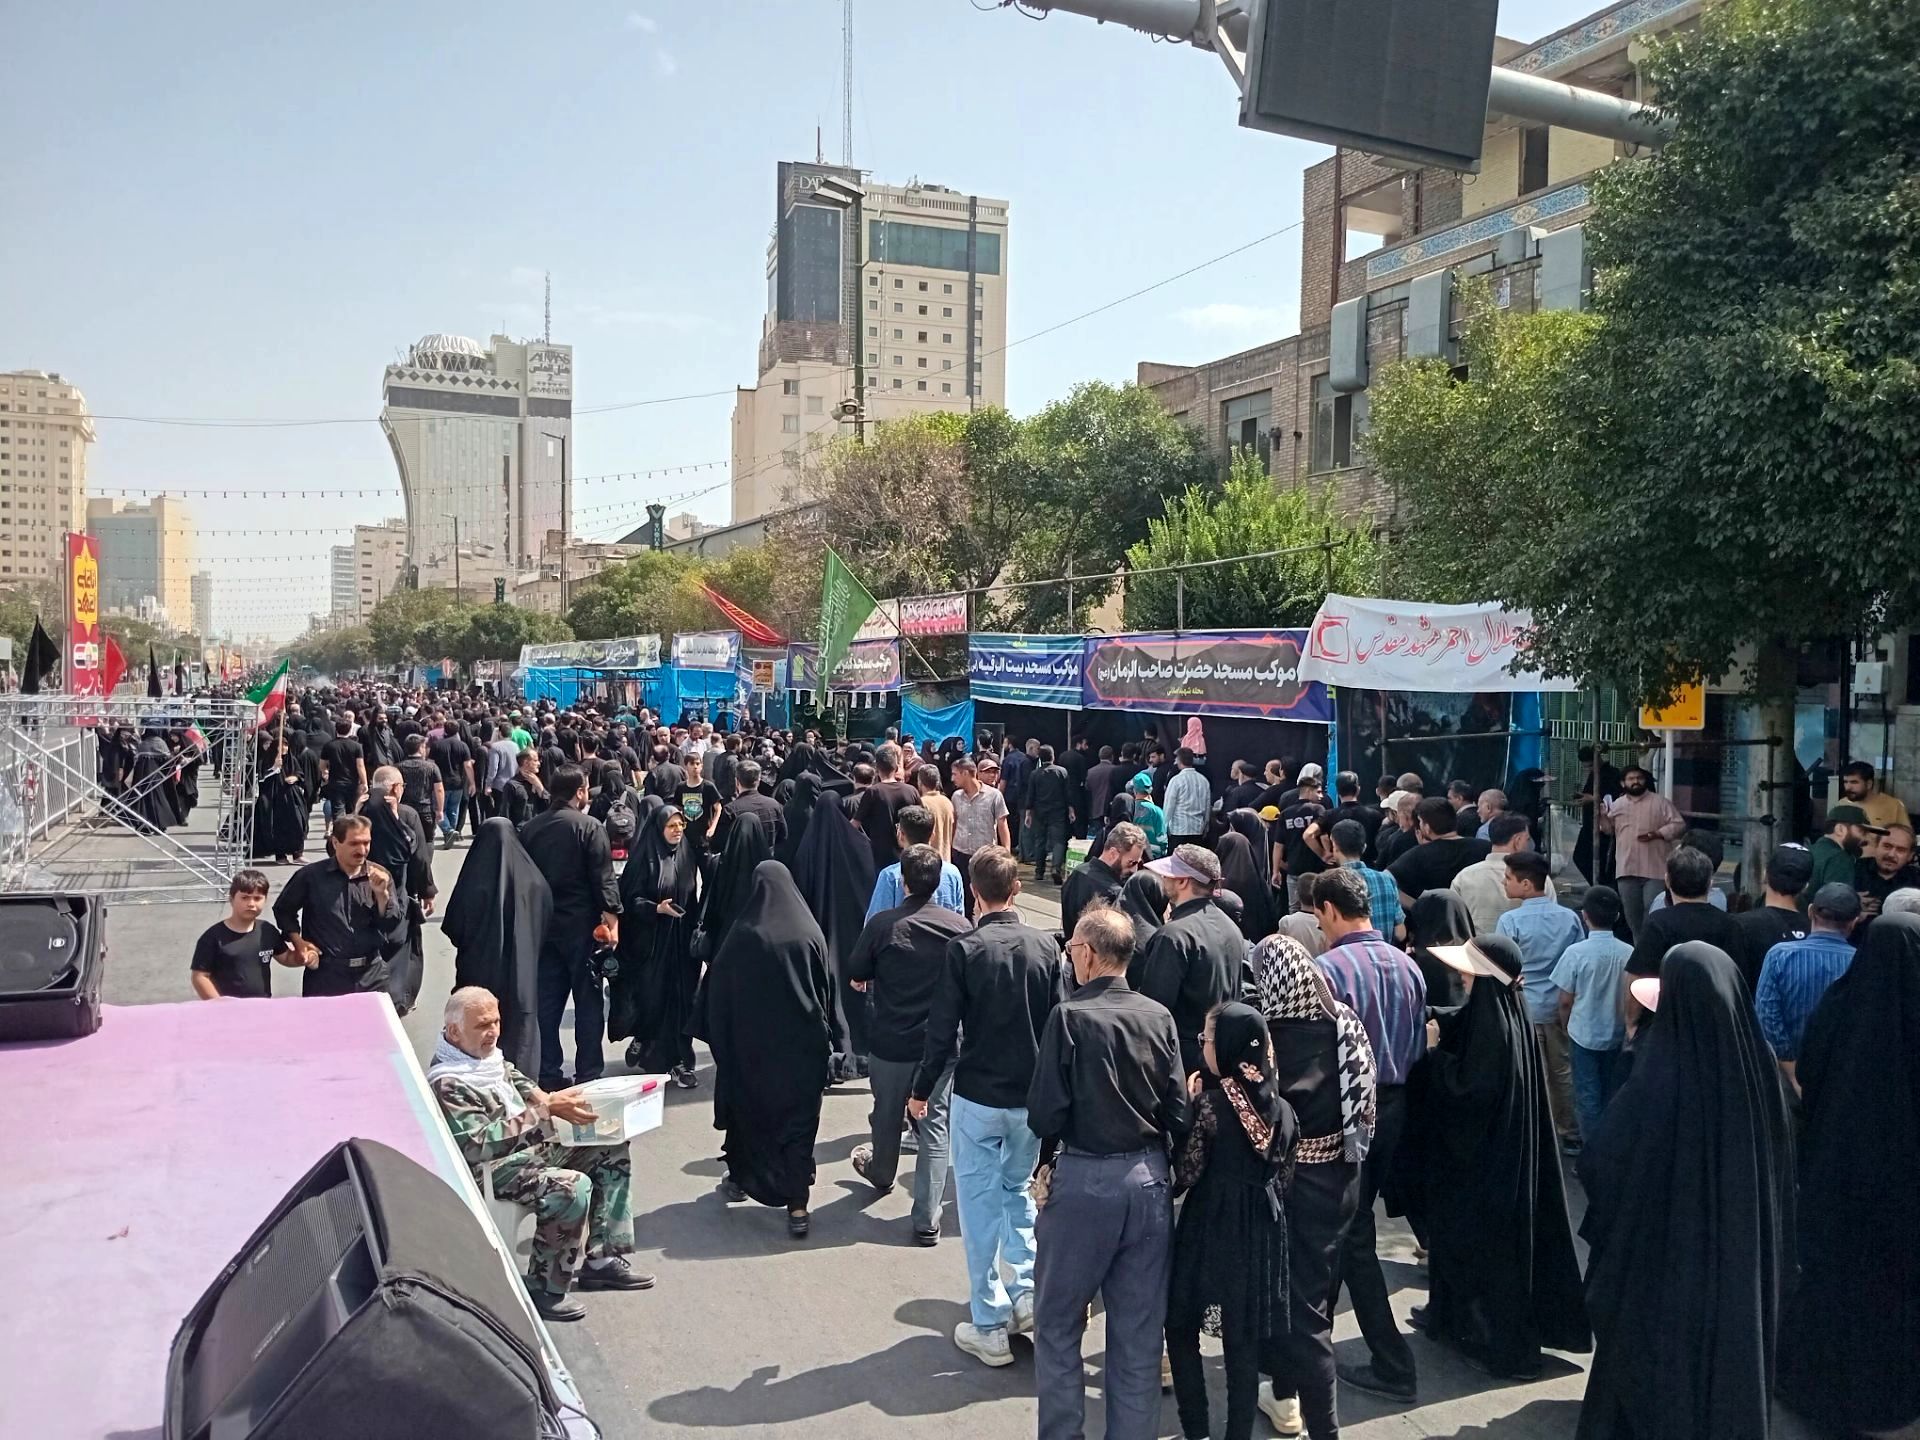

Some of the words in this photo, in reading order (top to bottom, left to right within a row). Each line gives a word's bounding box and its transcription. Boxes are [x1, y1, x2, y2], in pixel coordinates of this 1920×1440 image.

[1401, 615, 1441, 658] مشهد
[1005, 659, 1024, 677] بیت
[1025, 660, 1052, 678] مسجد
[1109, 659, 1138, 683] الزمان
[1137, 664, 1174, 683] صاحب
[1173, 658, 1213, 685] حضرت
[1213, 661, 1254, 685] مسجد
[1254, 658, 1297, 688] موکب
